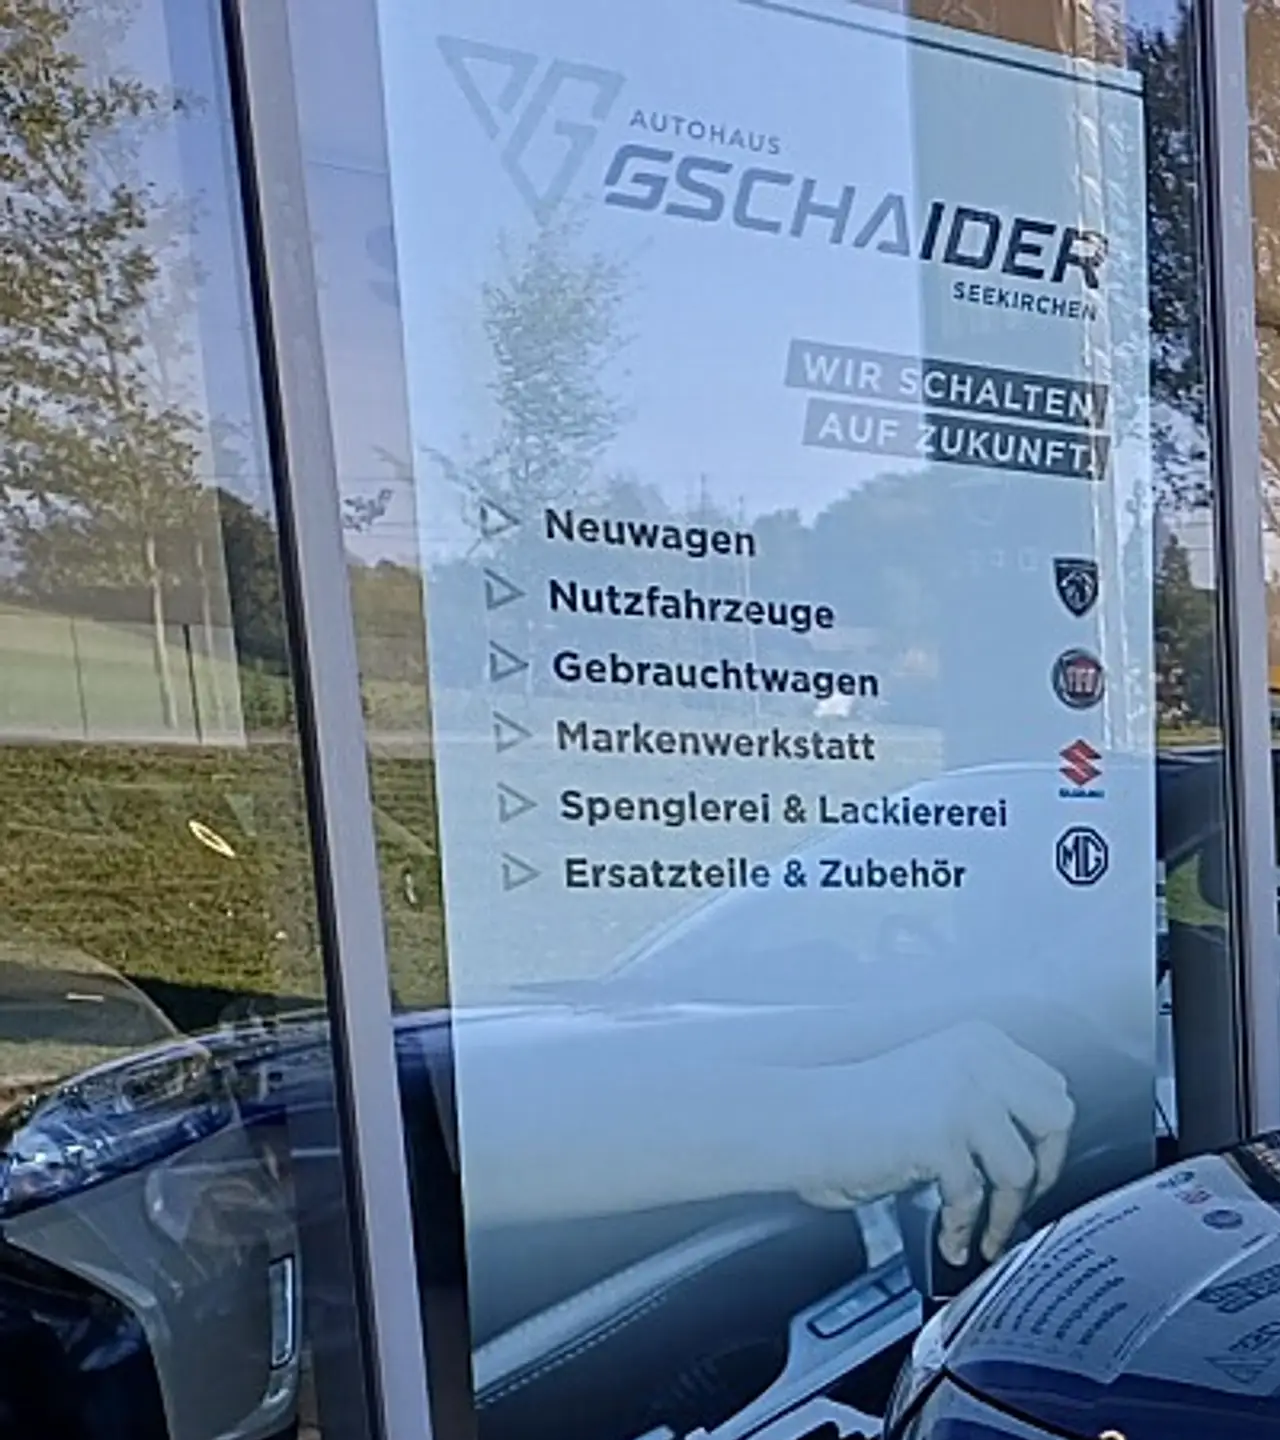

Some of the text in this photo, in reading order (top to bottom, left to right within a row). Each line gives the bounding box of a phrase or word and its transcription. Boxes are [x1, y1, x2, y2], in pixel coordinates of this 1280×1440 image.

[629, 108, 782, 155] AUTOHAUS
[603, 143, 1110, 290] GSCHAIDER
[952, 281, 1097, 322] SEEKIRCHEN
[803, 352, 1092, 419] WIR SCHALTEN
[818, 412, 900, 446] AUF
[545, 508, 756, 559] Neuwagen
[548, 579, 835, 634] Nutzfahrzeuge
[553, 651, 880, 700] Gebrauchtwagen
[556, 720, 877, 762] Markenwerkstatt
[559, 789, 1008, 828] Spenglerei & Lackiererei
[564, 857, 966, 889] Ersatzteile & Zubehör
